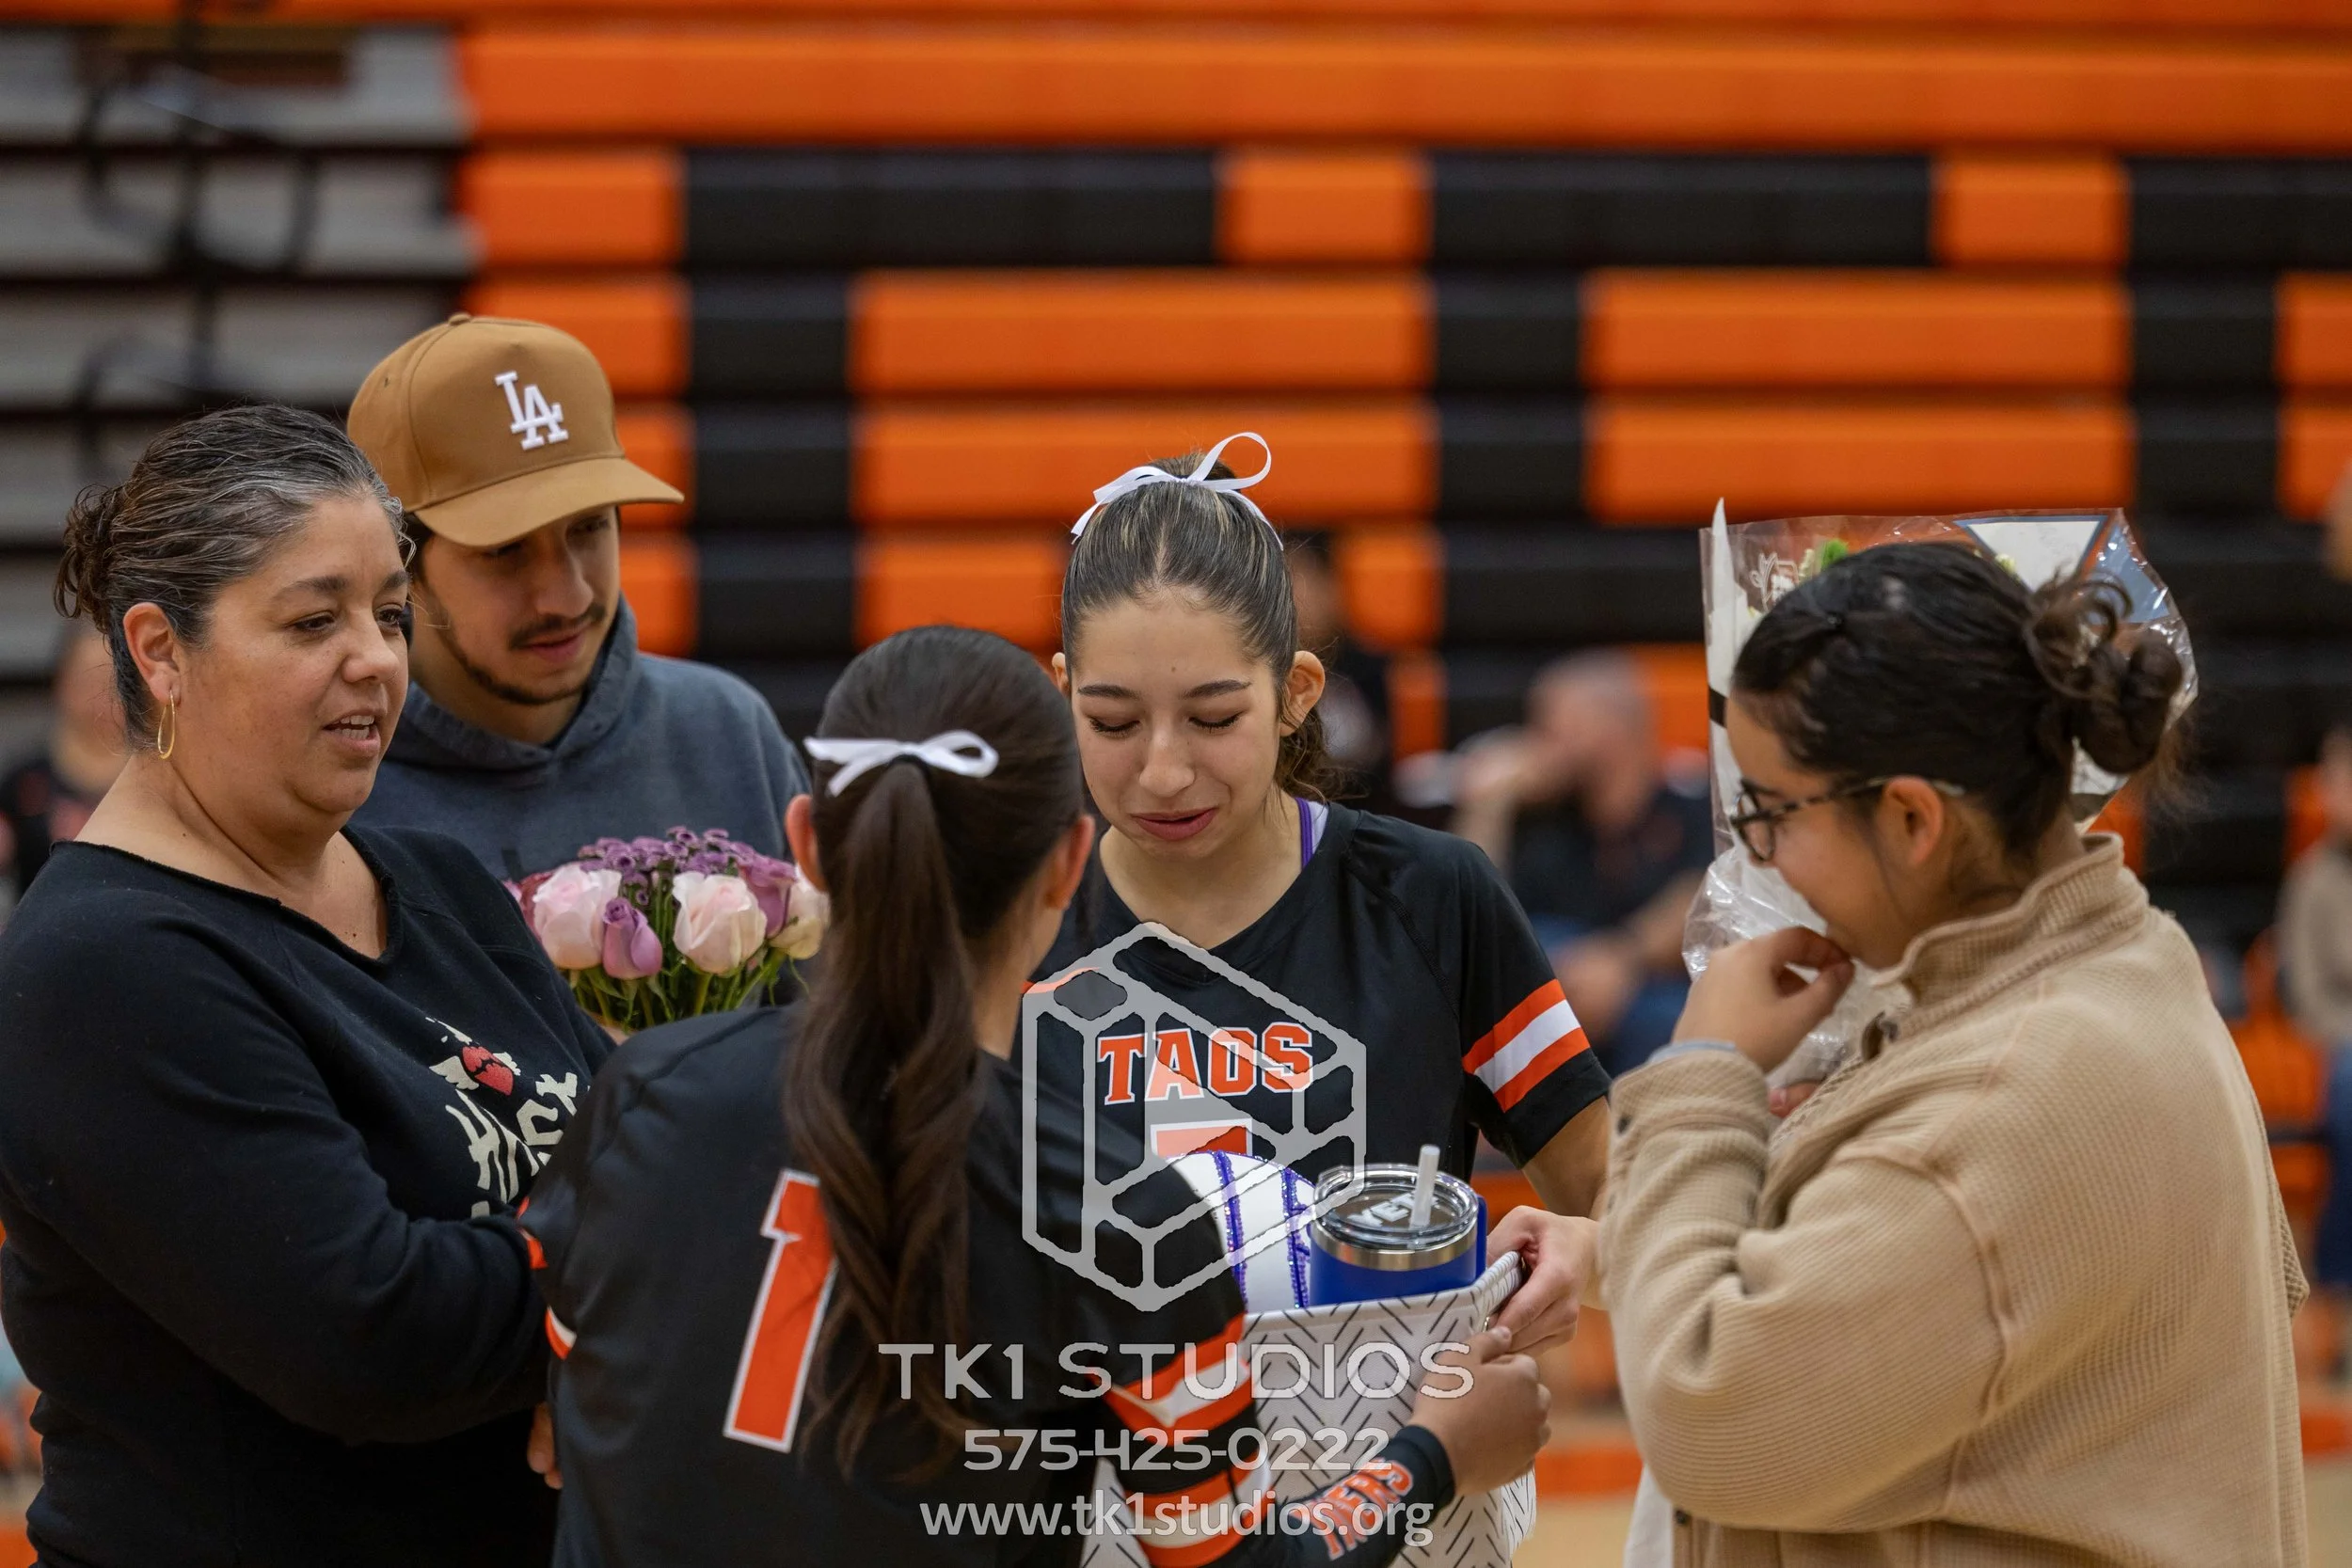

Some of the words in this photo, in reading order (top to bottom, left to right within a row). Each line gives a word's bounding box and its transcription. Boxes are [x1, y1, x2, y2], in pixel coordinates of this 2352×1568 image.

[495, 371, 569, 451] LA
[1096, 1022, 1314, 1106] TAOS
[1347, 1192, 1439, 1227] YET
